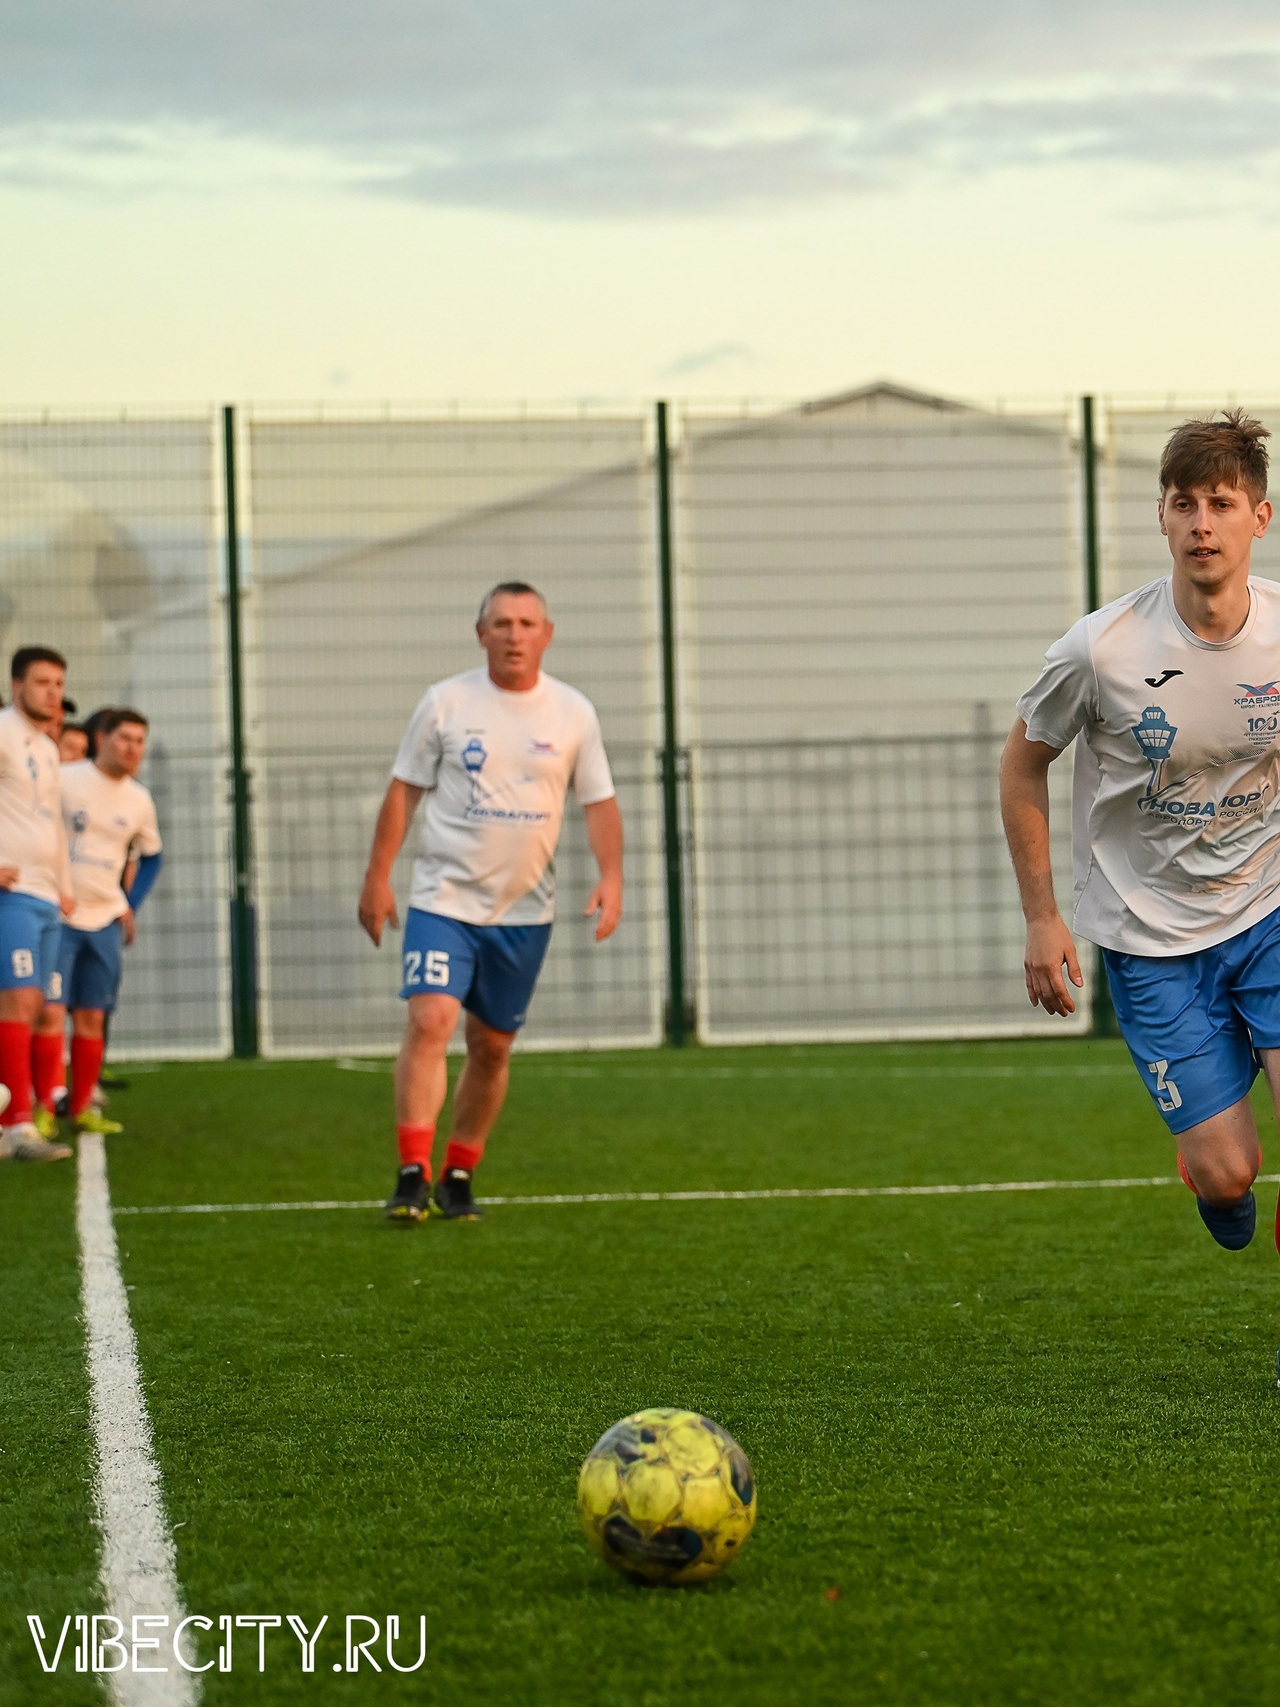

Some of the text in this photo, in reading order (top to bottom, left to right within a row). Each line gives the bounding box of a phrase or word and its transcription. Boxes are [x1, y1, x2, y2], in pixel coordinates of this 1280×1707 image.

[1247, 716, 1278, 732] 100
[405, 950, 450, 987] 25
[1147, 1059, 1182, 1112] 3
